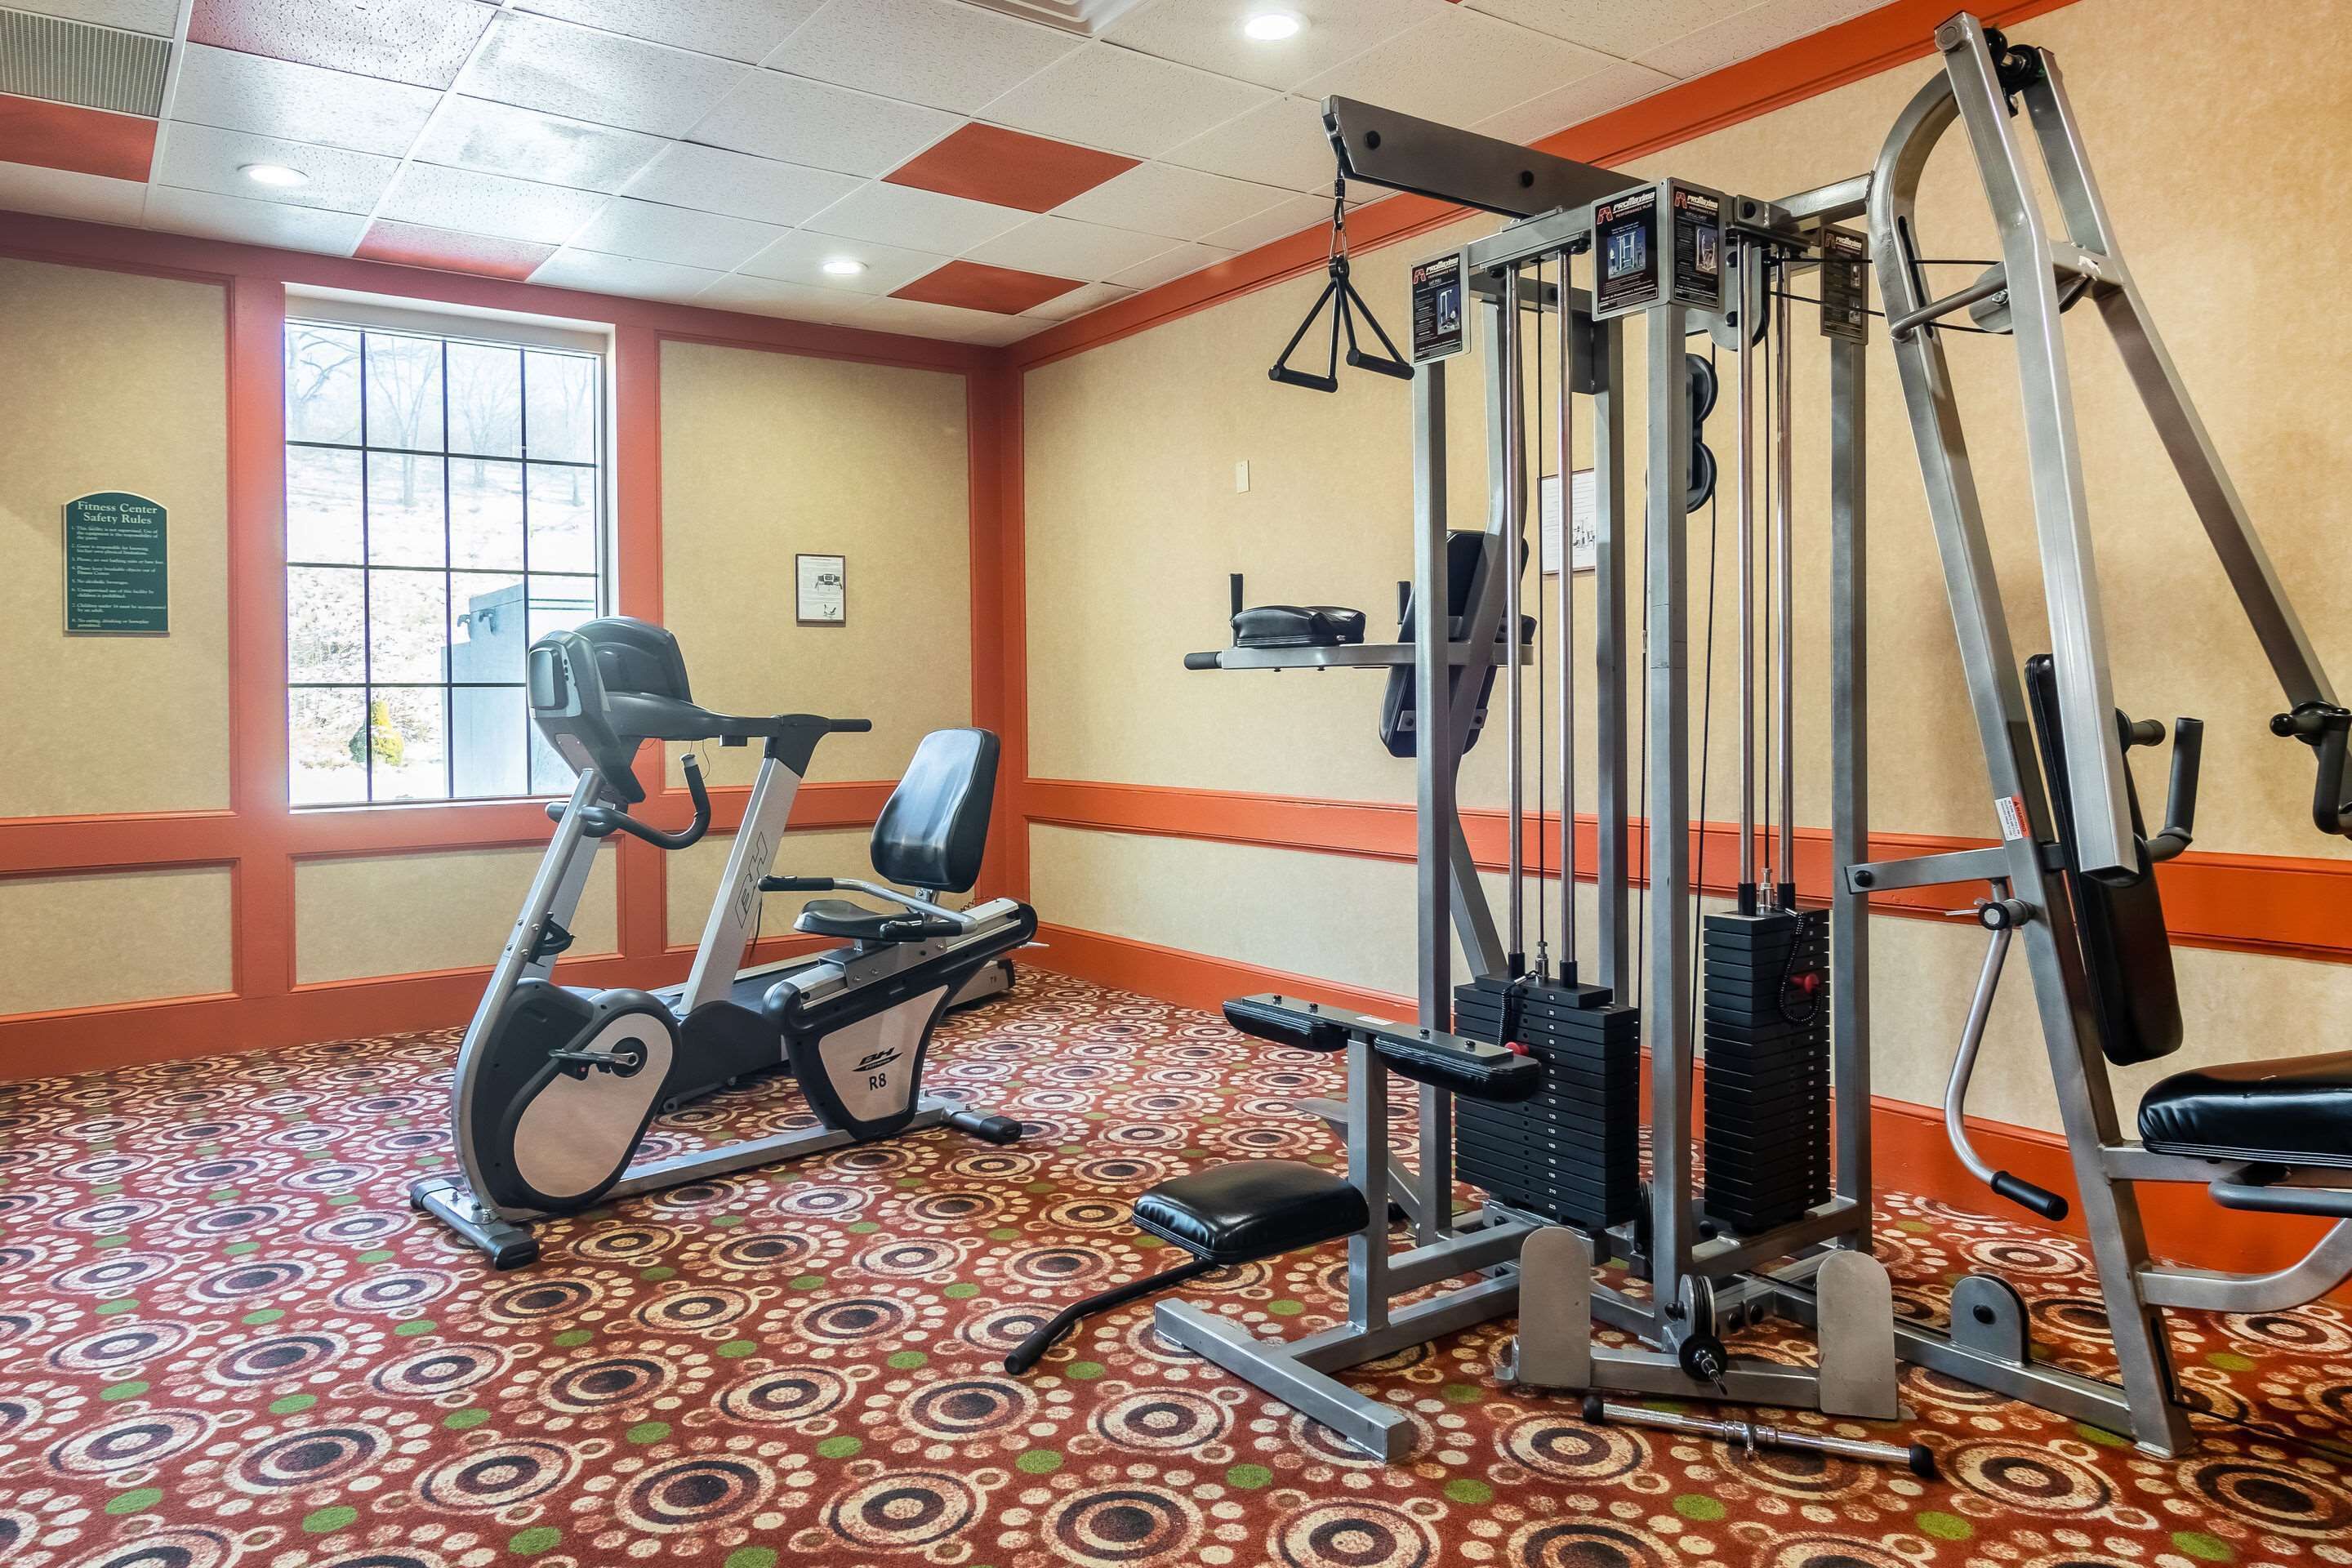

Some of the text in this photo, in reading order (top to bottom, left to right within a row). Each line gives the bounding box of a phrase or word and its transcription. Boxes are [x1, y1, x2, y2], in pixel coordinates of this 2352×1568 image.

[78, 501, 158, 514] Fitness Center
[83, 512, 152, 523] Safety Rules
[2016, 807, 2026, 831] WARNING
[869, 1073, 886, 1091] R8
